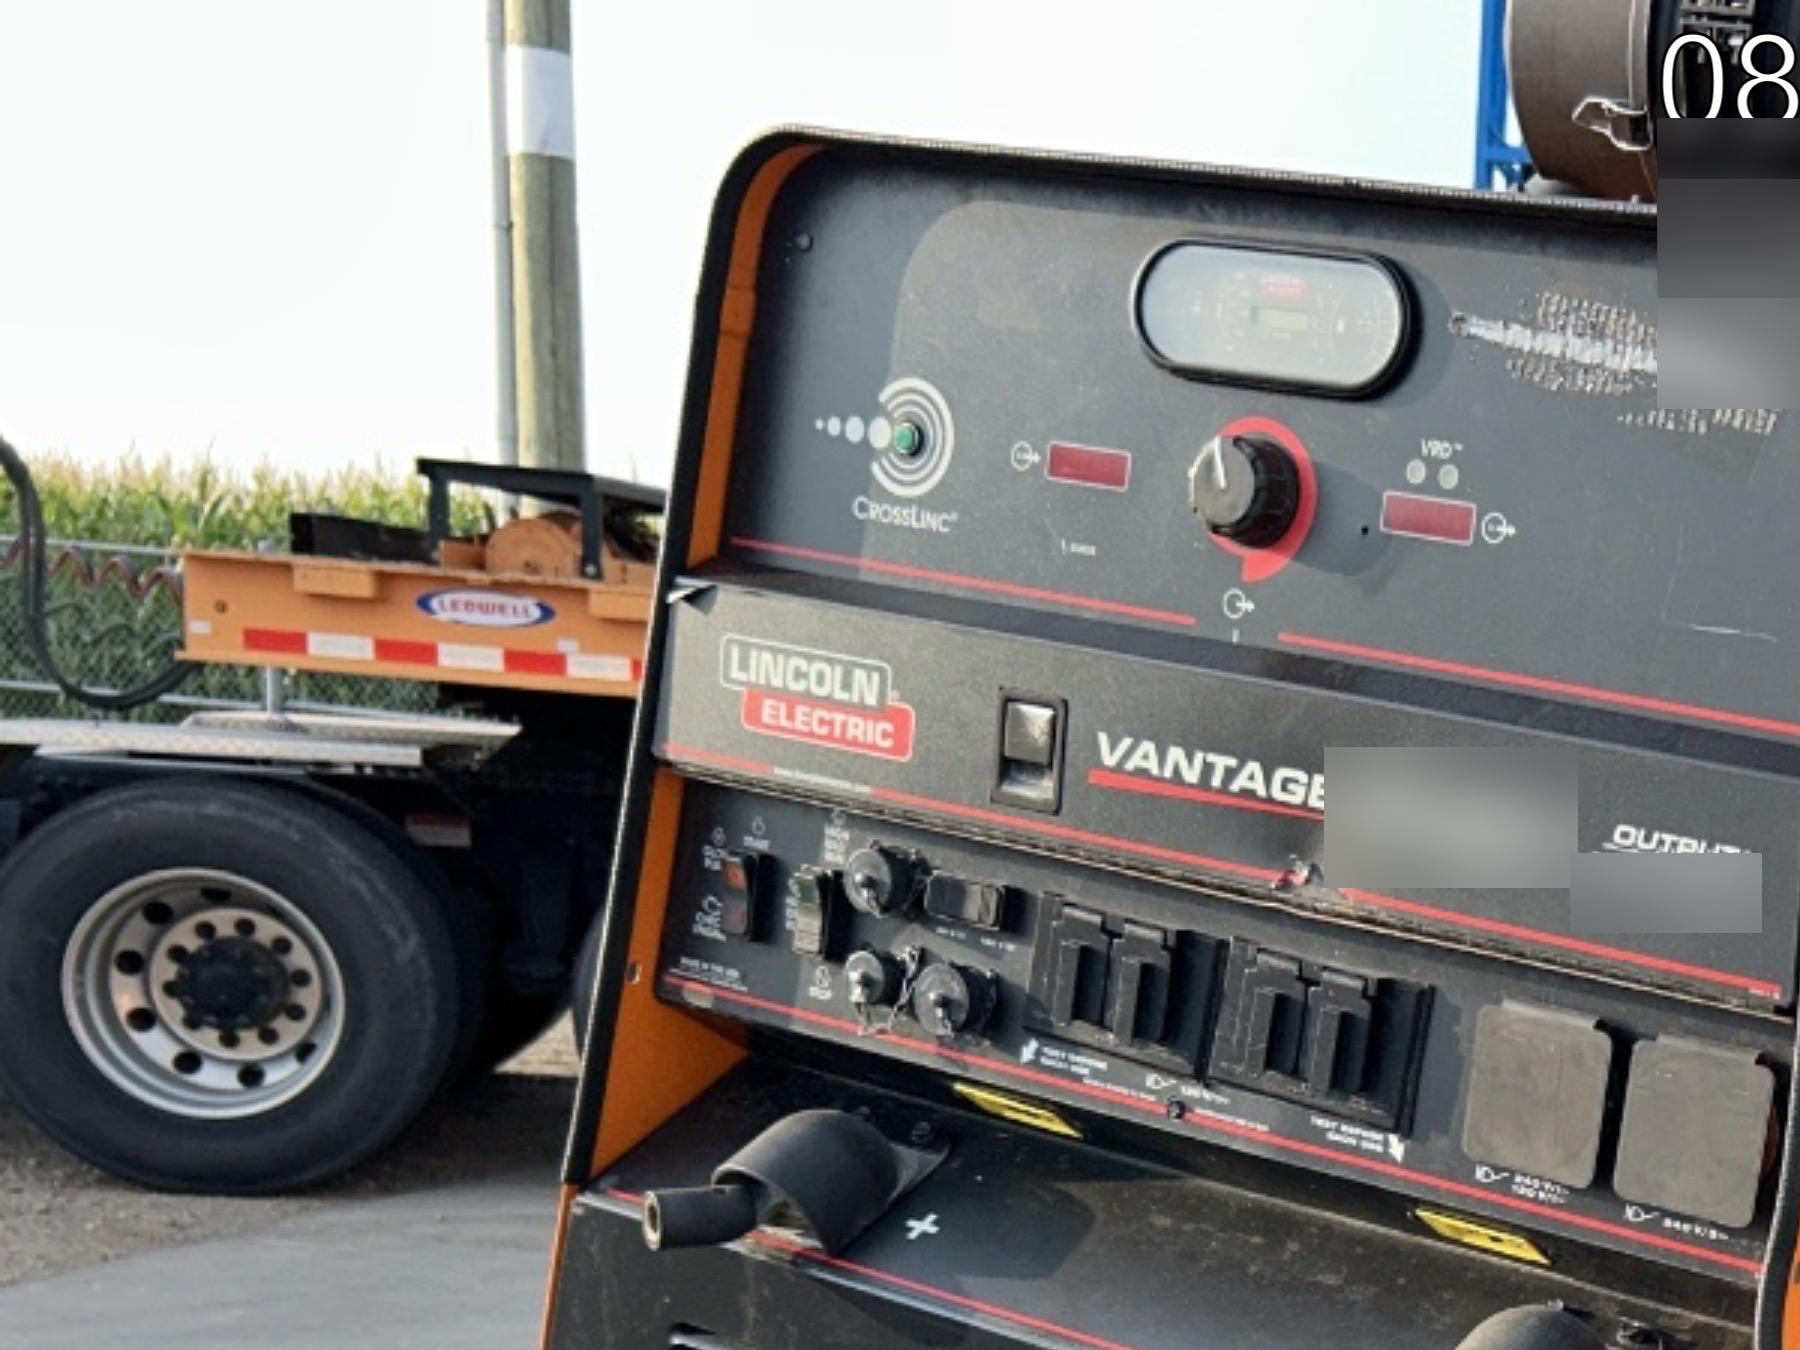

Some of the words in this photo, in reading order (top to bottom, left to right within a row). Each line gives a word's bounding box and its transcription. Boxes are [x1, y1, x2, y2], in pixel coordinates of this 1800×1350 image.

[437, 598, 532, 619] LEDWELL
[728, 644, 882, 707] LINCOLN
[761, 703, 896, 748] ELECTRIC
